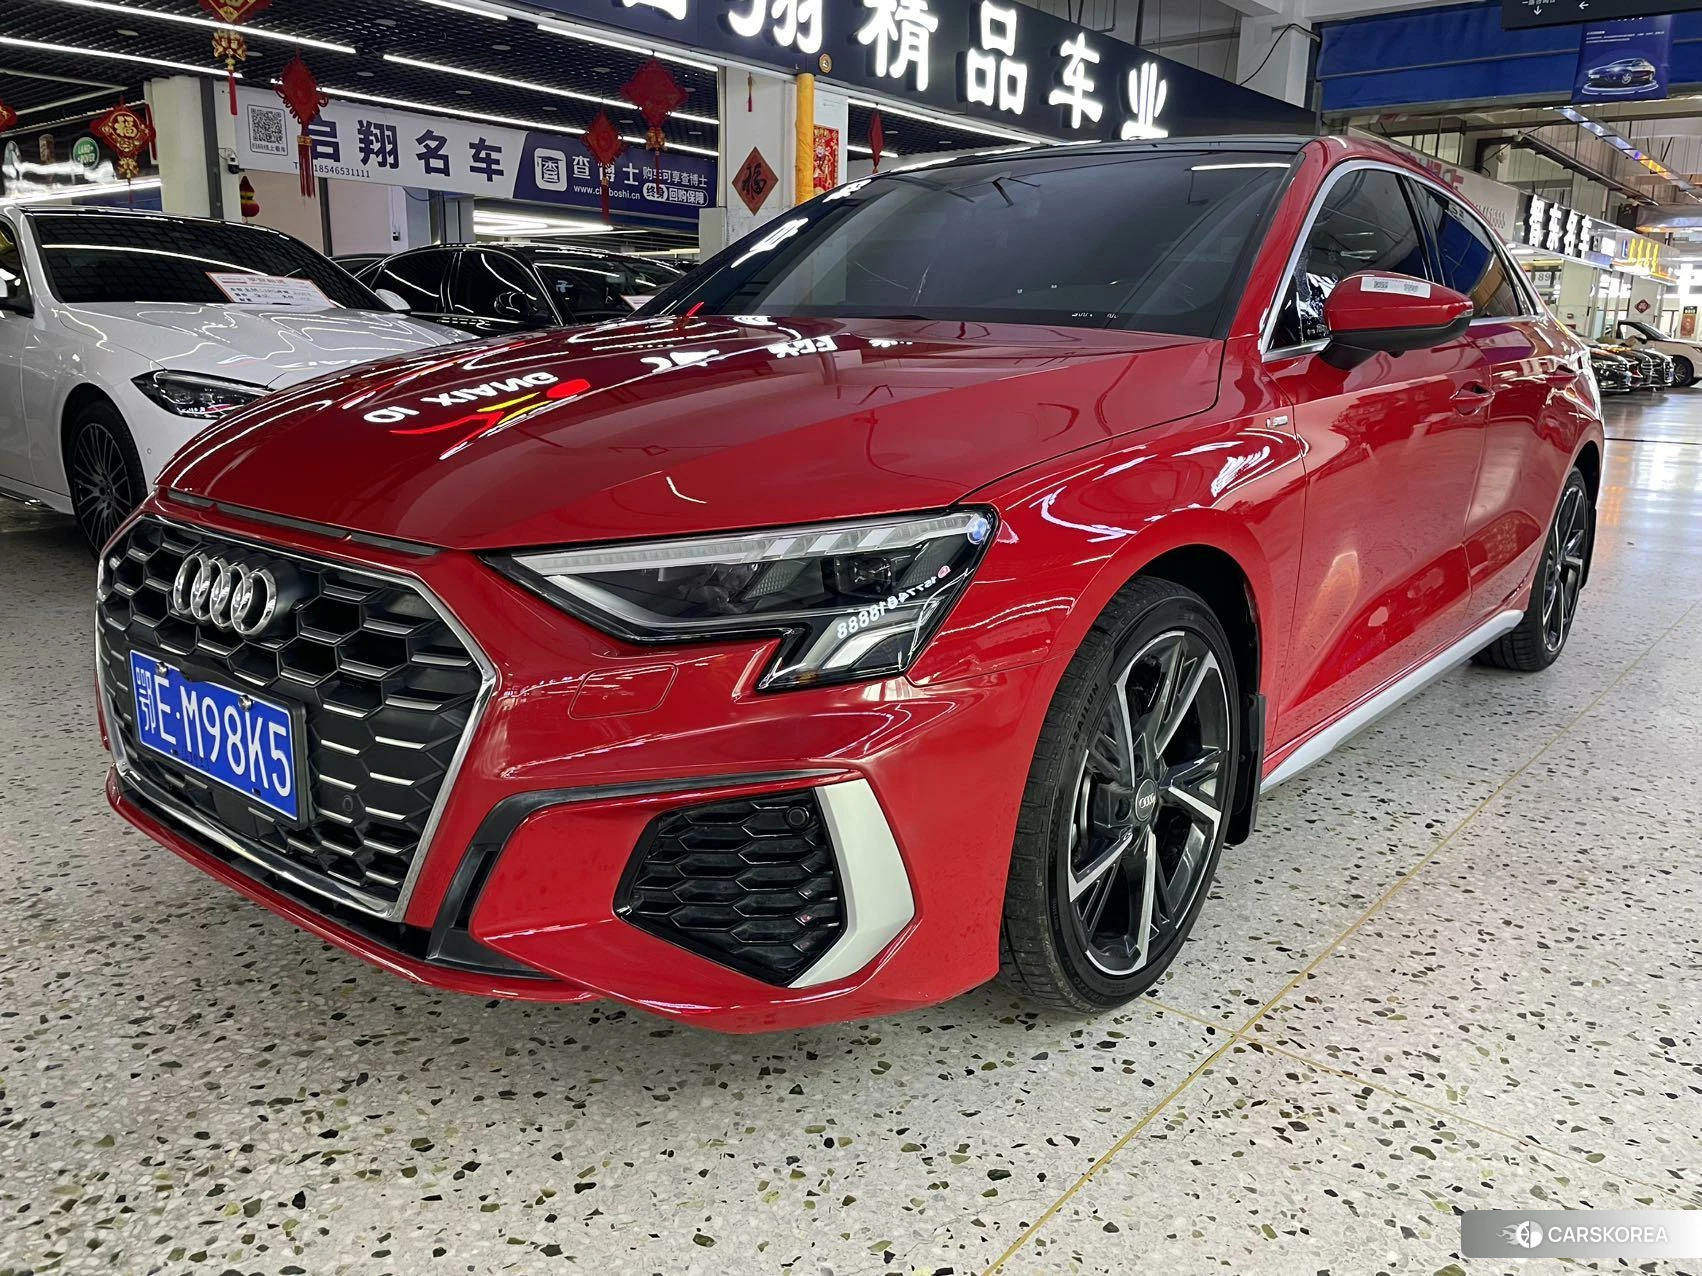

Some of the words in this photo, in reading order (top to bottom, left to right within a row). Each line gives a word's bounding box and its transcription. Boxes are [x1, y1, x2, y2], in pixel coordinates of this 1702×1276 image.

[621, 0, 1168, 141] 精品车业
[114, 115, 138, 137] 福
[308, 113, 504, 182] 启翔名车
[572, 155, 639, 185] 查博士
[643, 166, 708, 188] 购车可享查博士
[742, 161, 767, 199] 福
[573, 185, 641, 200] www.cboshi.cn
[1072, 681, 1100, 743] SAILUN
